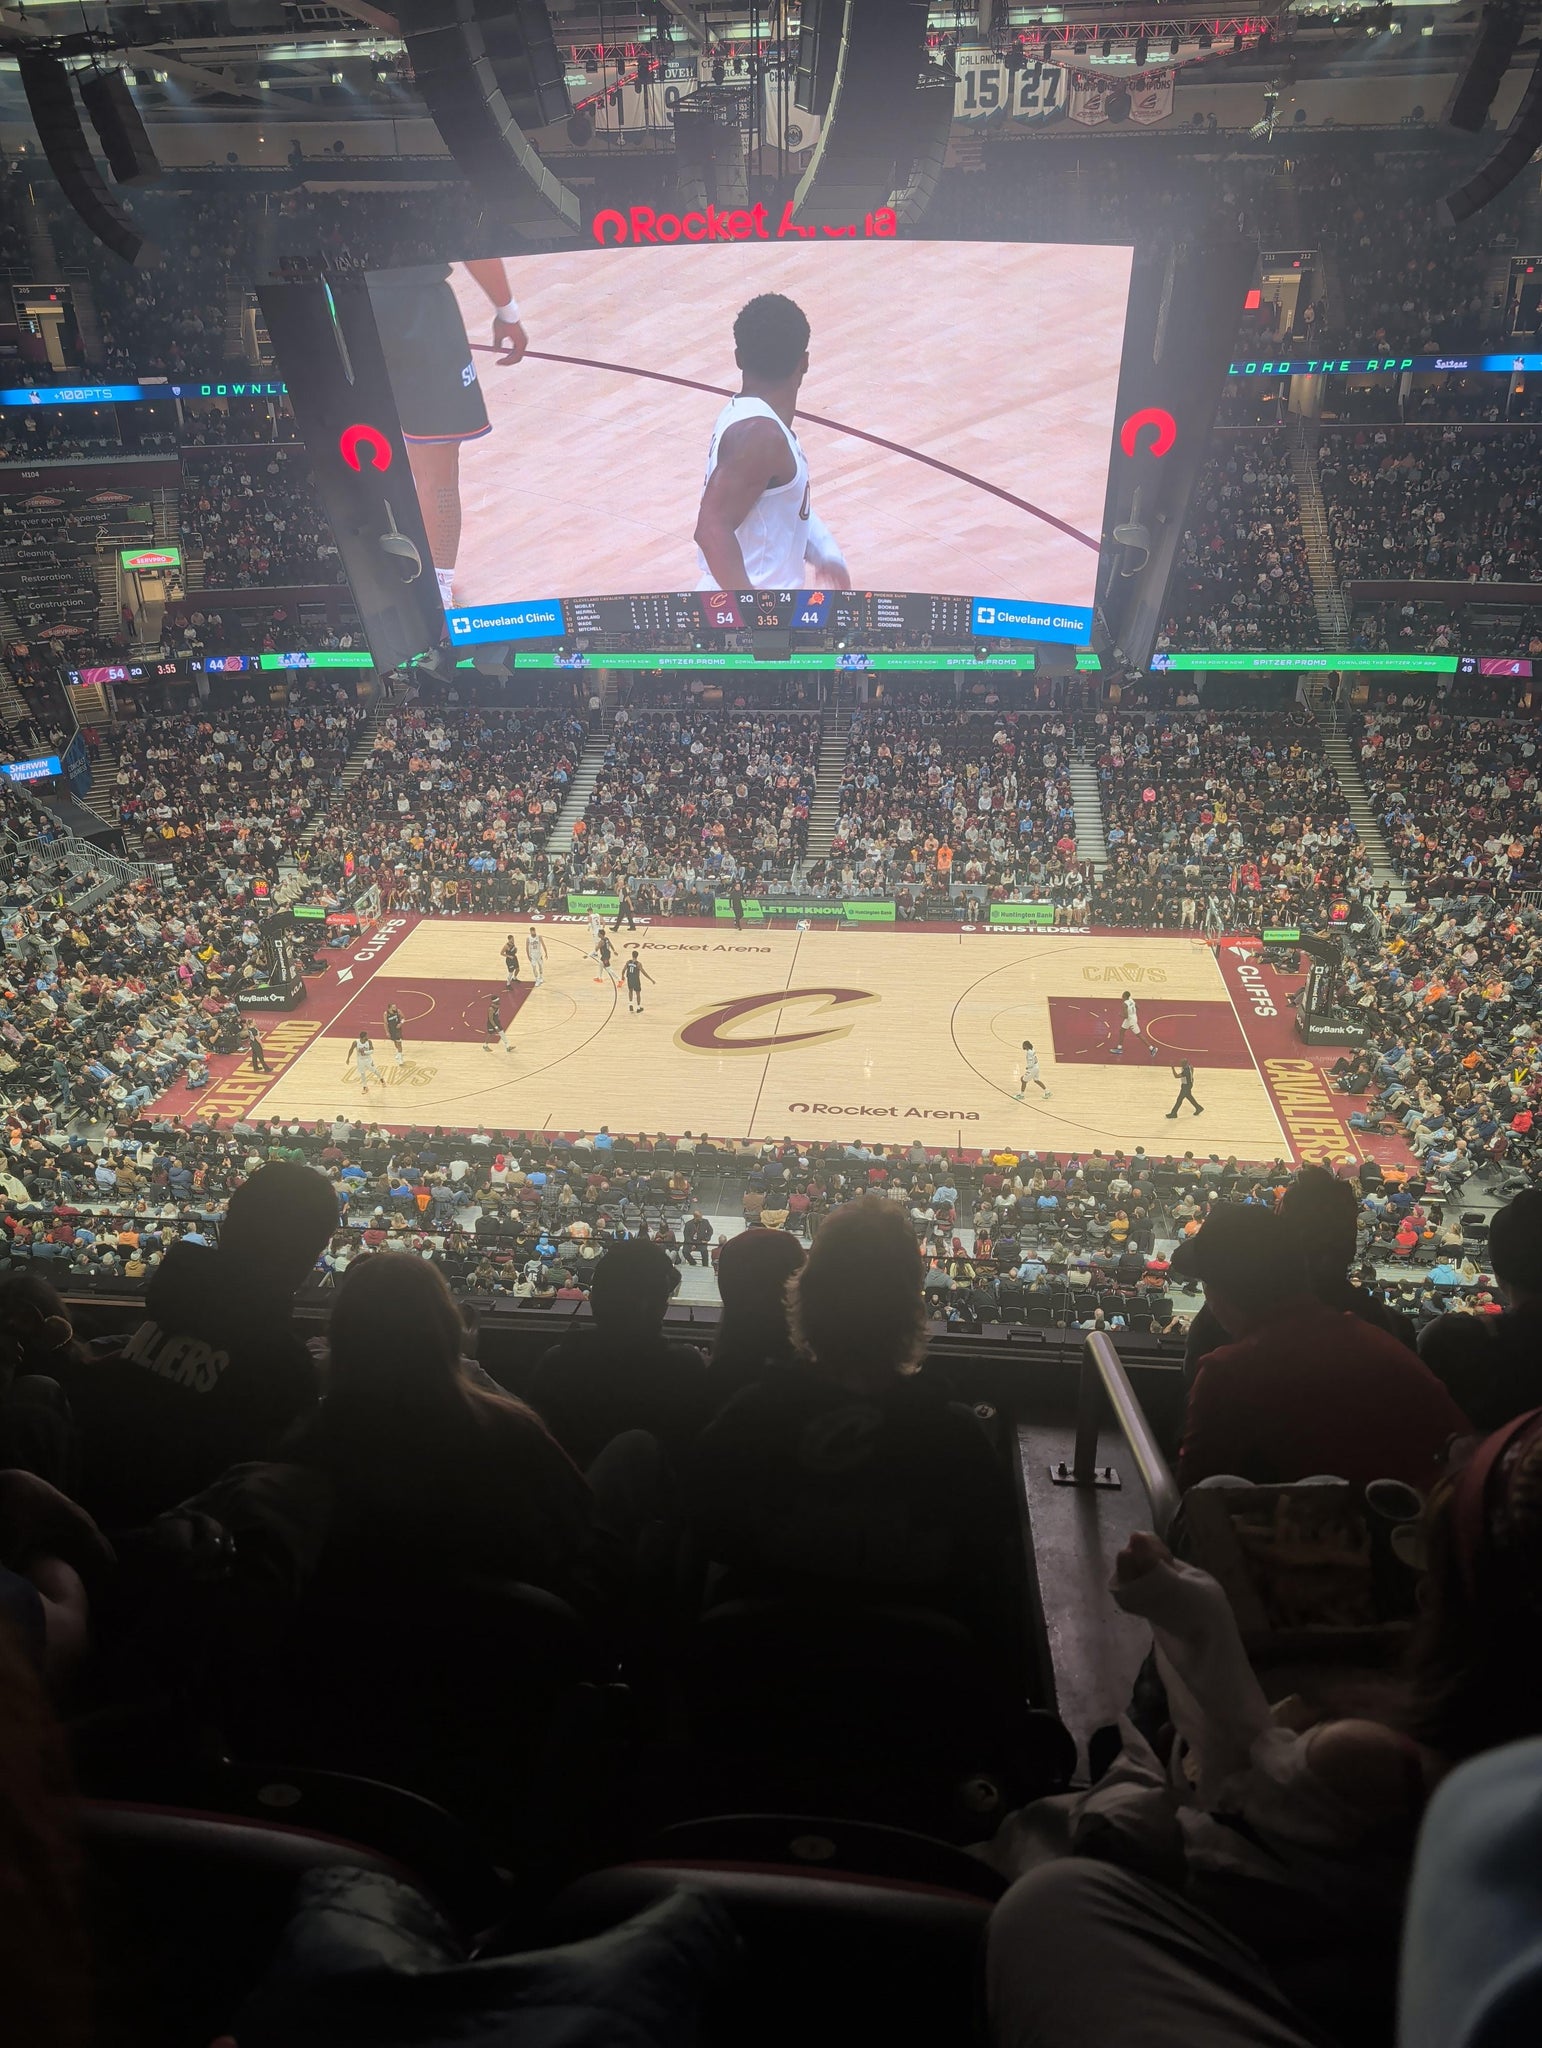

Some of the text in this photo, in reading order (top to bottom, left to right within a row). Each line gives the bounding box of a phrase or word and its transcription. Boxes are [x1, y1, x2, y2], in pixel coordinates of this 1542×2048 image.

[964, 70, 1000, 108] 15
[1020, 68, 1060, 108] 27
[630, 201, 769, 243] Rocket
[1308, 361, 1351, 372] THE
[1367, 359, 1413, 371] APP
[21, 471, 40, 479] M104
[41, 516, 62, 525] even
[136, 556, 167, 564] SERVPRO
[21, 573, 74, 584] Restoration.
[740, 595, 754, 603] 2Q
[780, 593, 791, 603] 24
[29, 598, 86, 610] Construction.
[472, 612, 556, 629] Cleveland Clinic
[716, 612, 734, 624] 54
[757, 615, 778, 626] 3:55
[801, 612, 819, 624] 44
[997, 611, 1084, 630] Cleveland Clinic
[157, 664, 177, 675] 3:55
[192, 662, 202, 671] 24
[210, 660, 224, 670] 44
[1461, 665, 1473, 673] 49
[1510, 663, 1521, 674] 4
[109, 669, 125, 680] 54
[131, 668, 143, 676] 2Q
[72, 677, 79, 685] 2
[9, 760, 48, 773] SHERWIN
[578, 902, 610, 910] Huntington
[762, 906, 846, 915] LET EM KNOW.
[1333, 910, 1345, 920] 24
[982, 925, 1091, 934] TRUSTEDSEC
[353, 918, 407, 962] CLIFFS
[641, 942, 772, 954] Rocket Arena
[1082, 963, 1168, 983] CAVS
[1237, 965, 1278, 1017] CLIFFS
[239, 994, 270, 1003] KeyBank
[1309, 1025, 1345, 1035] KeyBank
[812, 1103, 980, 1121] Rocket Arena
[1263, 1058, 1357, 1164] CAVALIERS
